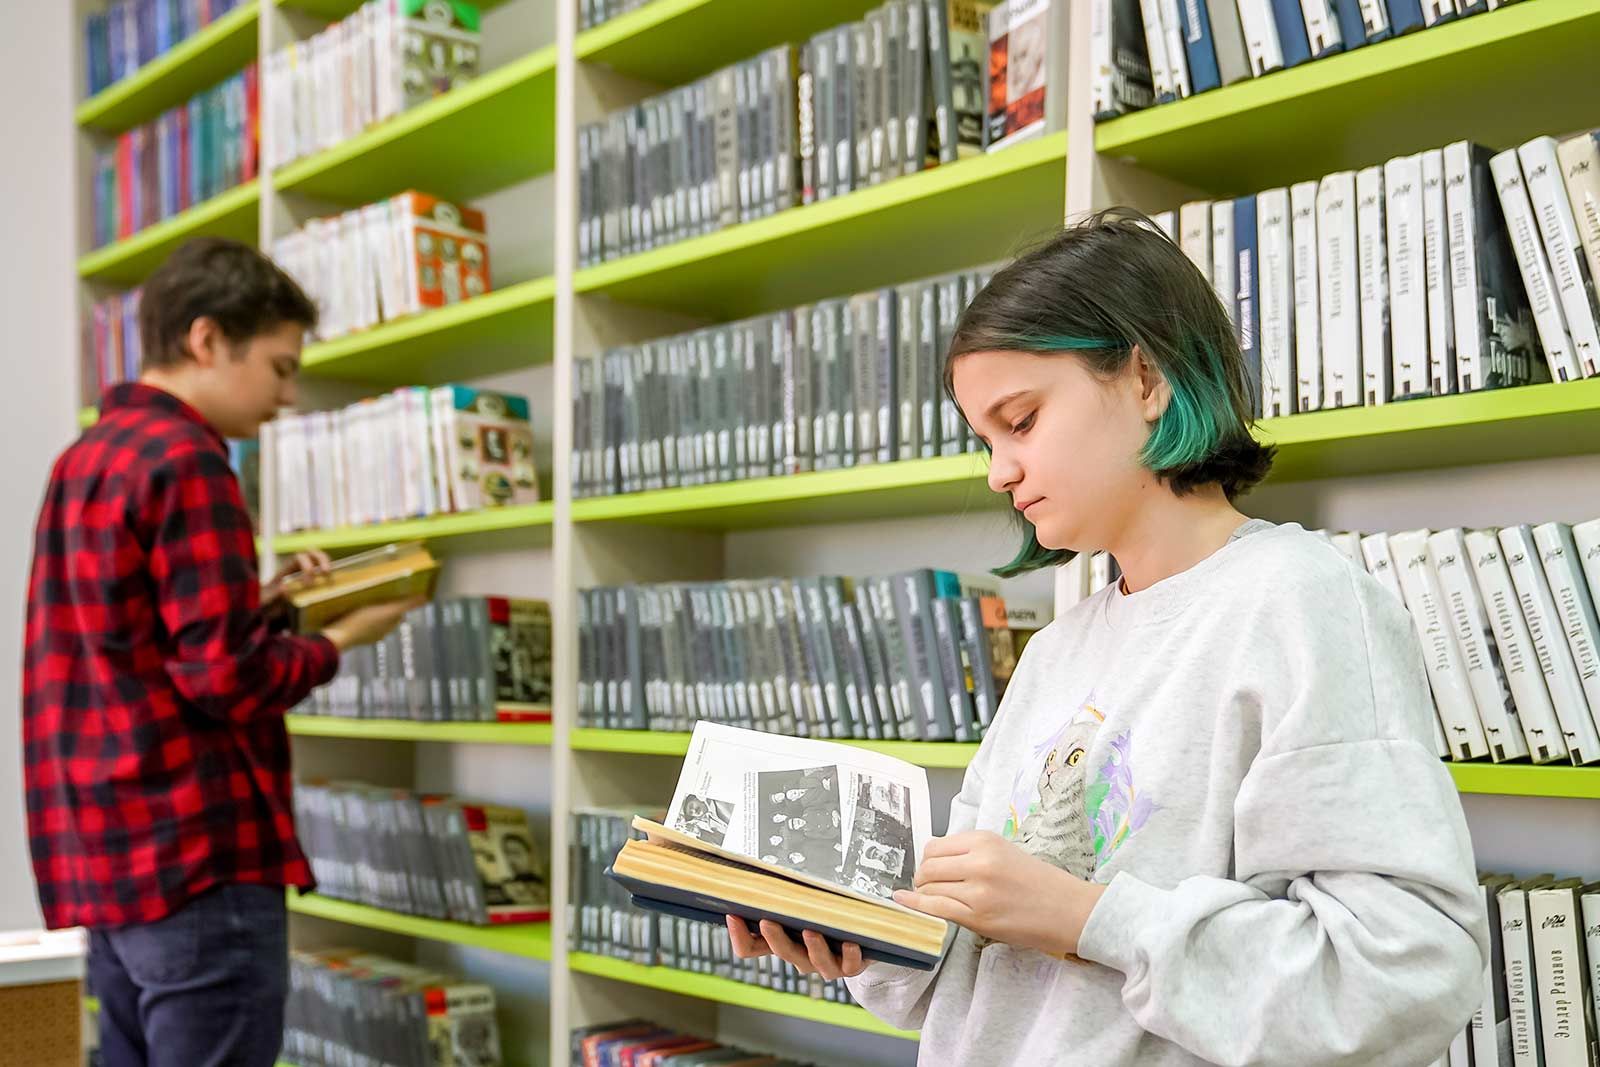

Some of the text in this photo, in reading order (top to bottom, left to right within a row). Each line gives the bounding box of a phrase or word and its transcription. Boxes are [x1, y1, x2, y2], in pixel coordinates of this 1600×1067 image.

[1451, 591, 1484, 672] Давид Самойлов
[1492, 591, 1525, 673] Лидия Смирнова
[1521, 593, 1555, 676] Лидия Смирнова
[1560, 587, 1598, 681] Муслим Магомаев
[1510, 960, 1529, 1056] Анатолий Рыбаков
[1550, 950, 1571, 1038] Эльдар Рязанов
